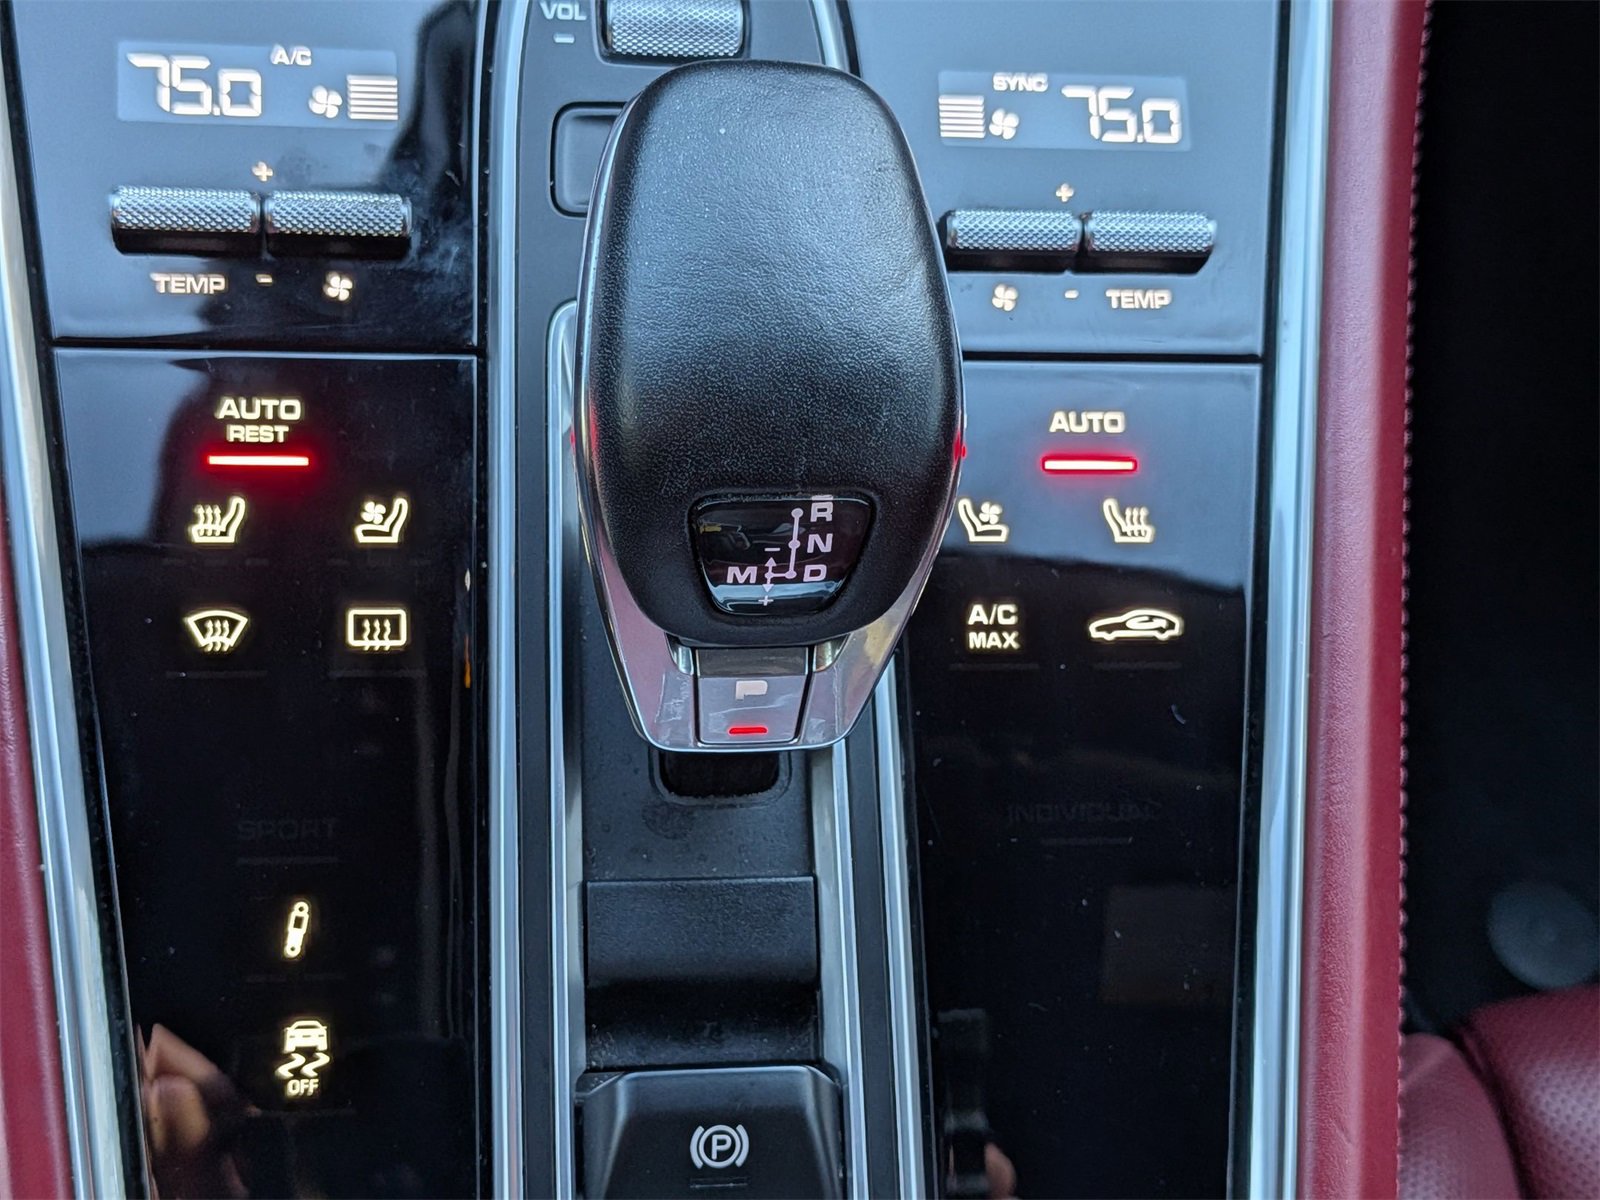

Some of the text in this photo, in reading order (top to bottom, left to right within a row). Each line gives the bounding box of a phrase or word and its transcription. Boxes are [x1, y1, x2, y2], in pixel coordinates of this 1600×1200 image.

[539, 0, 588, 20] VOL
[270, 43, 312, 66] A/C
[126, 53, 262, 117] 75.0
[992, 72, 1049, 92] SYNC
[1061, 84, 1182, 144] 75.0
[150, 272, 226, 294] TEMP
[1105, 288, 1172, 309] TEMP
[215, 396, 302, 420] AUTO
[1049, 411, 1126, 433] AUTO
[226, 424, 290, 443] REST
[810, 501, 834, 522] R
[807, 533, 834, 554] N
[726, 566, 758, 584] M
[802, 564, 828, 582] D
[967, 604, 1019, 625] A/C
[967, 631, 1021, 650] MAX
[236, 817, 340, 841] SPORT
[286, 1078, 320, 1097] OFF
